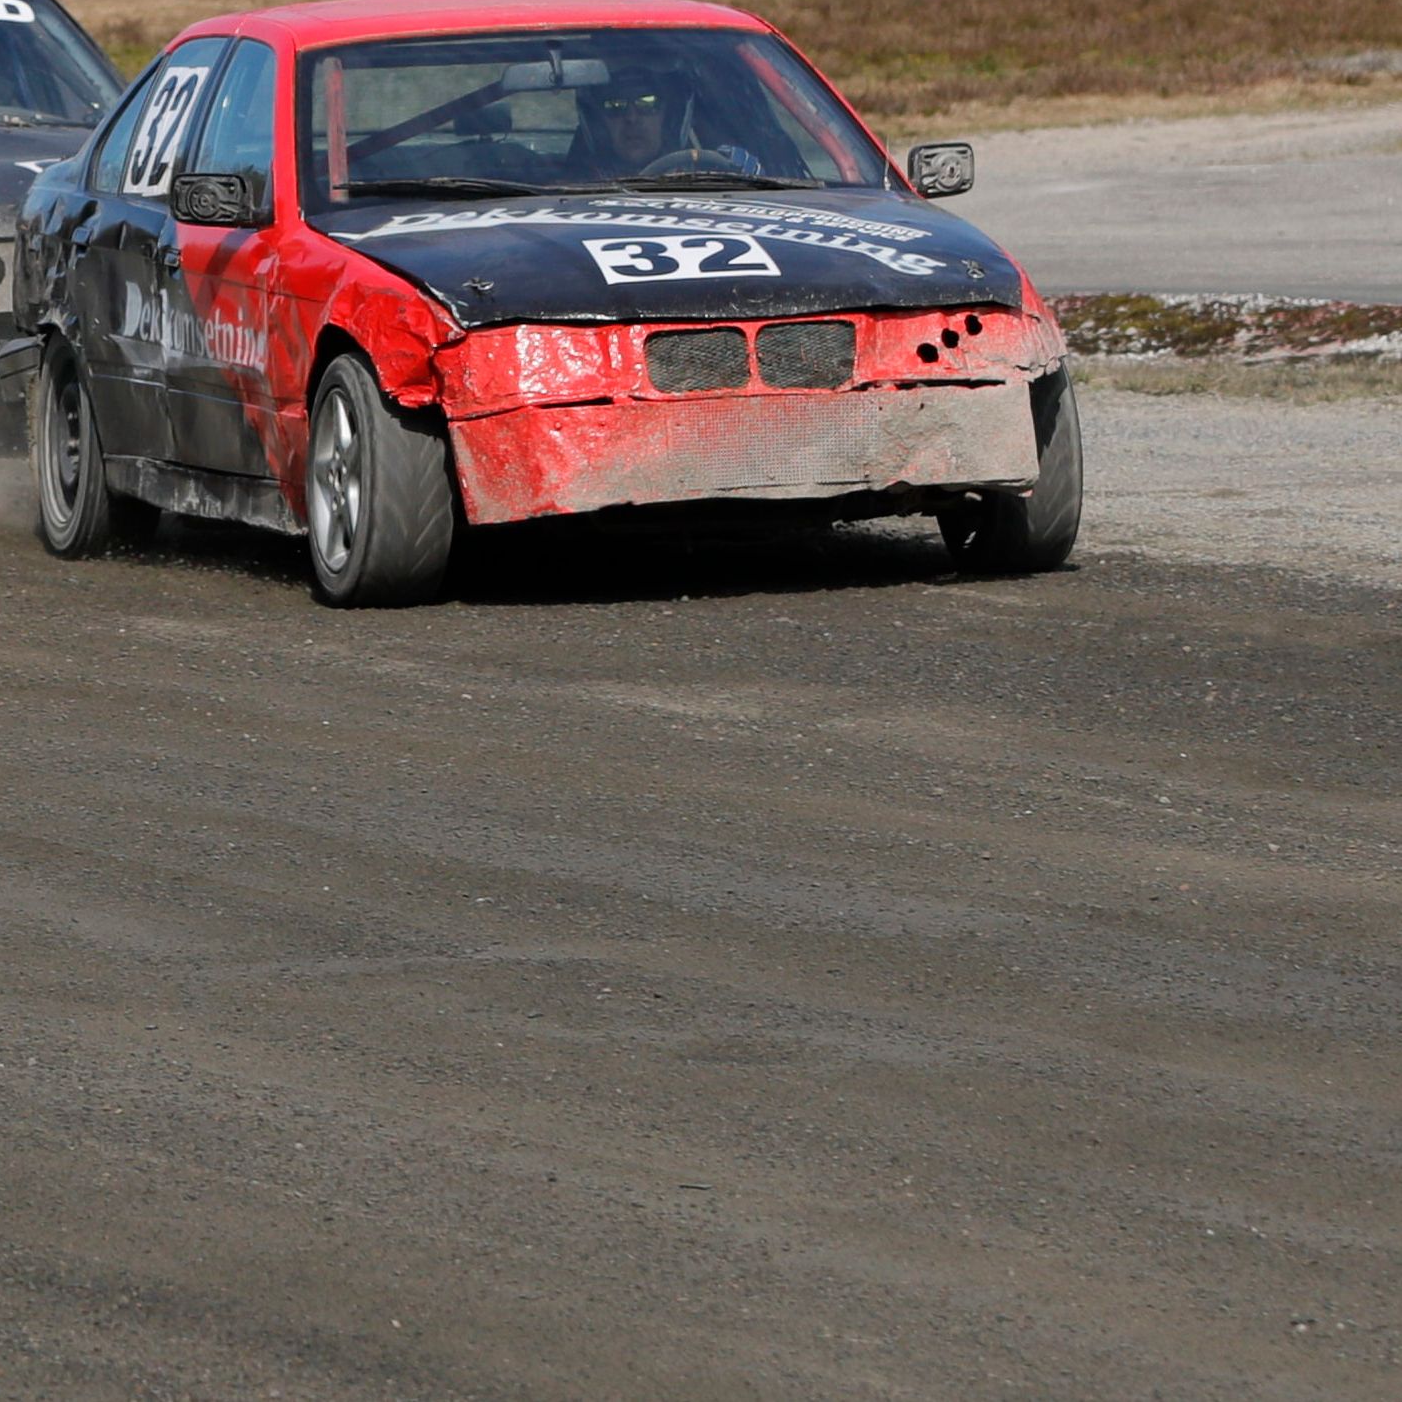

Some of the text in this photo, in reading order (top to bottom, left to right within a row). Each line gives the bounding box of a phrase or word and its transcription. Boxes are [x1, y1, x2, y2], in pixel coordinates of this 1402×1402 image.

[130, 74, 199, 187] 32
[382, 206, 947, 276] Dekkomsetning
[600, 237, 769, 278] 32
